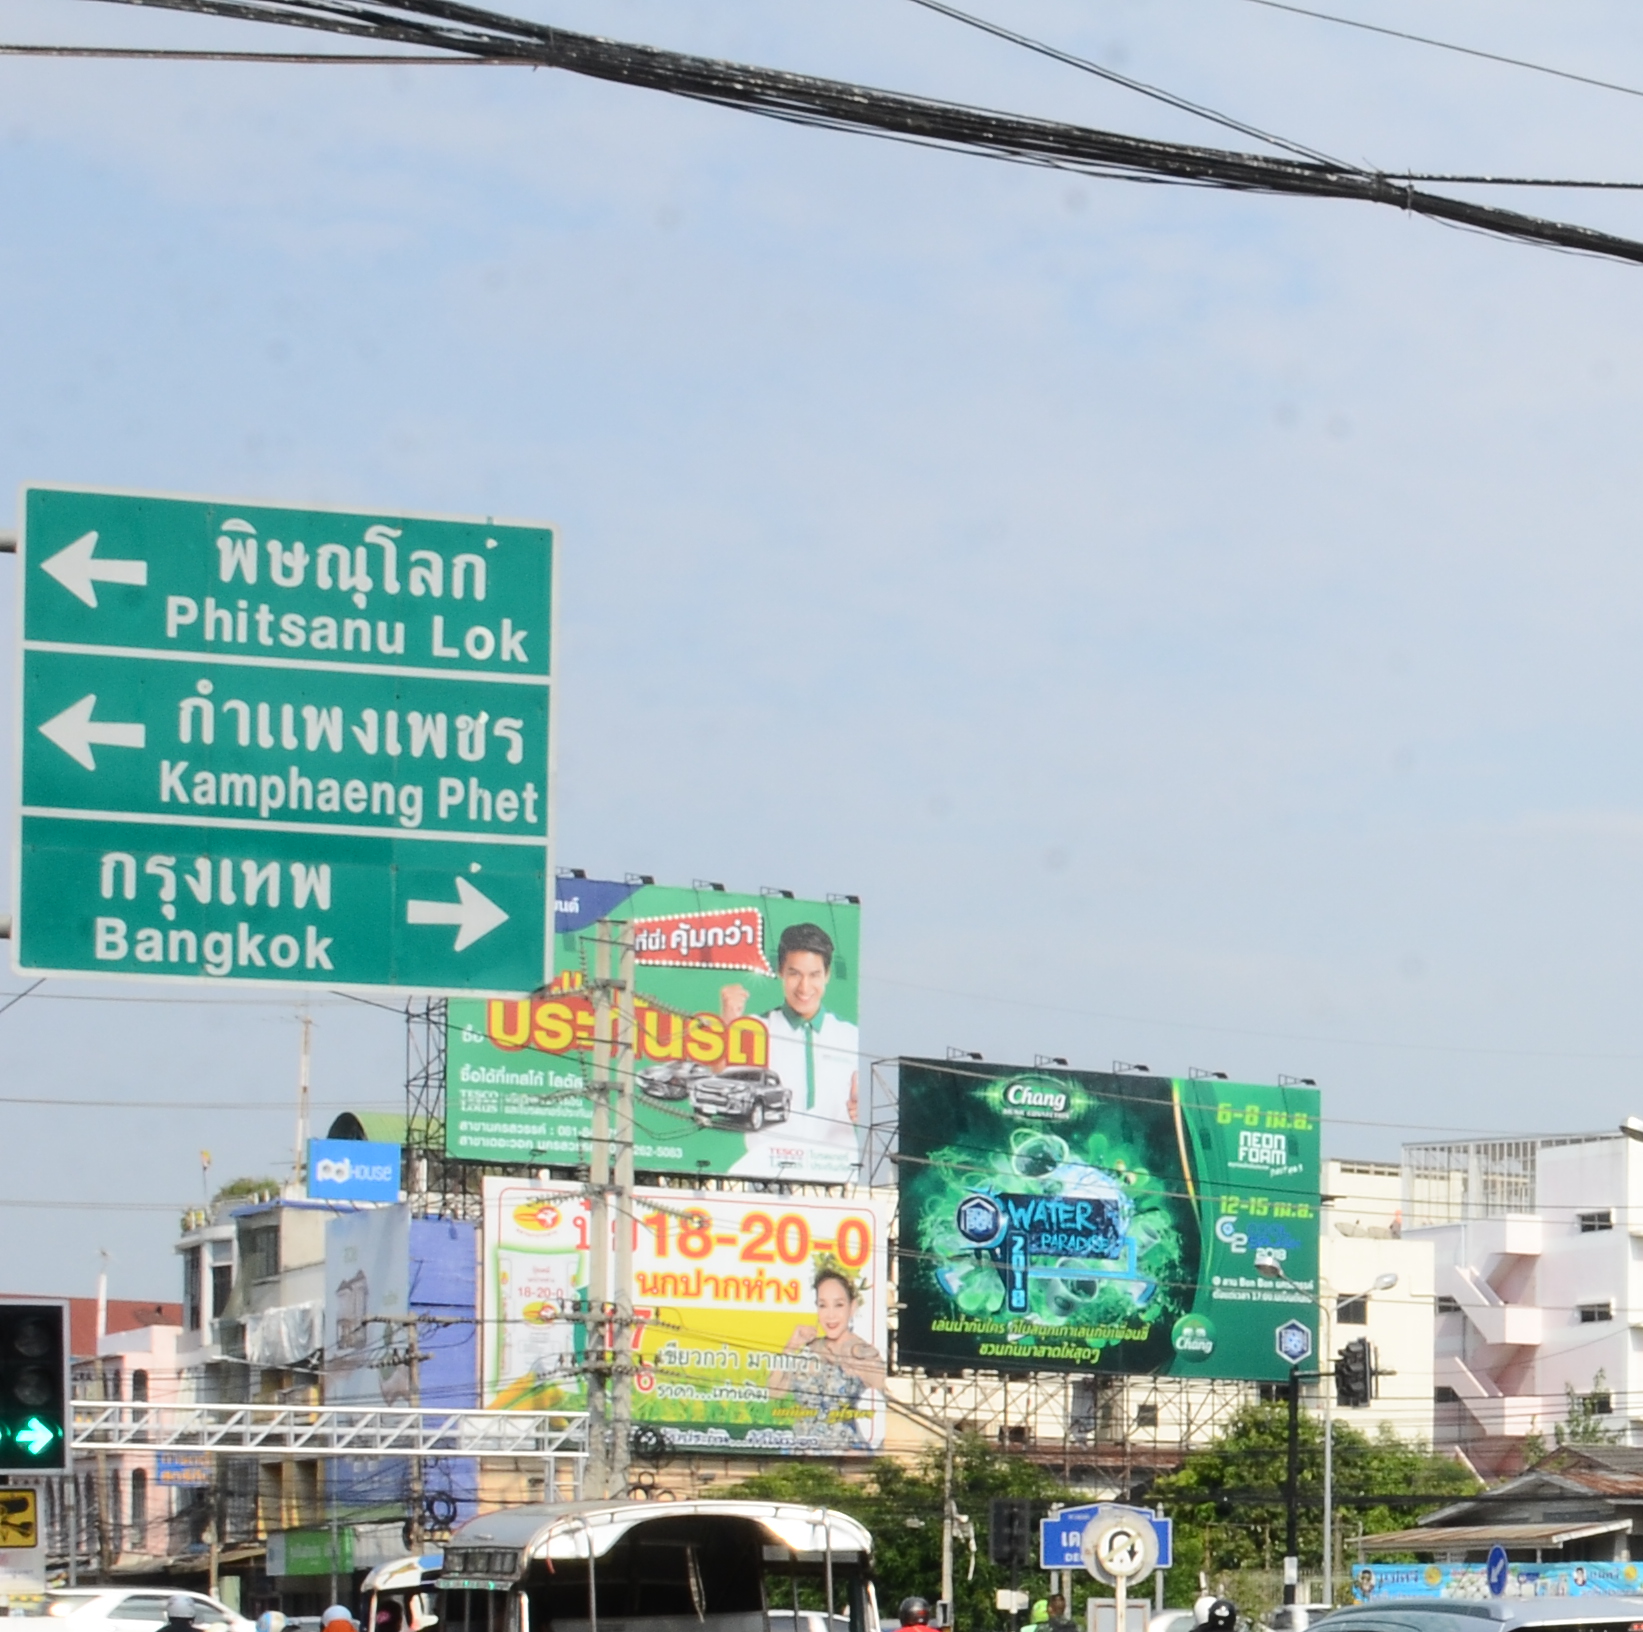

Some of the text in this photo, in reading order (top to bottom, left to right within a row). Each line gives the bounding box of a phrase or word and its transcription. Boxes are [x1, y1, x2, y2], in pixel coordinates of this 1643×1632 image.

[216, 518, 487, 609] พิษณุโลก
[166, 595, 529, 663] Phitsanu Lok
[179, 679, 524, 764] กำแพงเพชร
[160, 760, 539, 828] Kamphaeng Phet
[101, 851, 332, 921] กรุงเทพ
[95, 916, 334, 976] Bangkok
[669, 919, 754, 955] คุ้มกว่า
[1007, 1084, 1067, 1112] Chang
[1217, 1102, 1260, 1127] 6-8
[1238, 1147, 1286, 1166] FOAM
[1008, 1197, 1097, 1232] WATER
[1220, 1195, 1269, 1217] 12-15
[643, 1206, 873, 1269] 18-20-0
[1041, 1233, 1110, 1253] PARADISE
[635, 1268, 801, 1304] นกปากห่าง
[1012, 1235, 1026, 1308] 2018
[517, 1286, 564, 1299] 18-20-0
[1176, 1336, 1214, 1355] Chang
